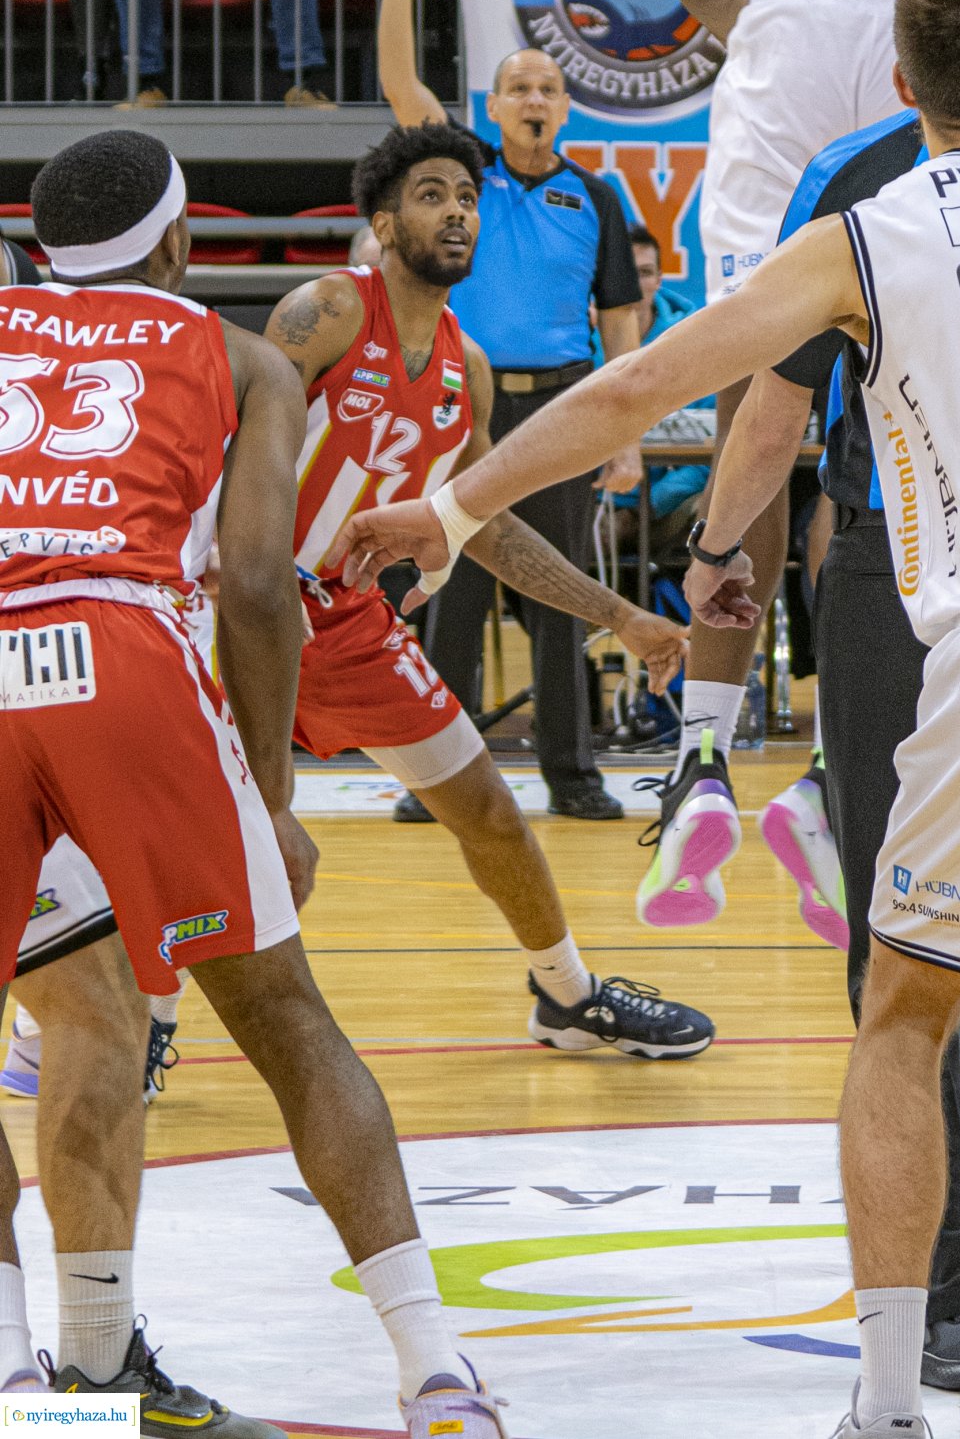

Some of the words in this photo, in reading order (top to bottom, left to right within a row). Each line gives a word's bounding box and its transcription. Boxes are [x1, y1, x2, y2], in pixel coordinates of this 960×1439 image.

[0, 353, 146, 461] 53
[344, 393, 374, 411] MOL
[363, 411, 422, 476] 12
[888, 426, 922, 598] Continental
[897, 868, 909, 888] H
[892, 898, 916, 914] 99.4
[890, 1418, 914, 1429] FREAK
